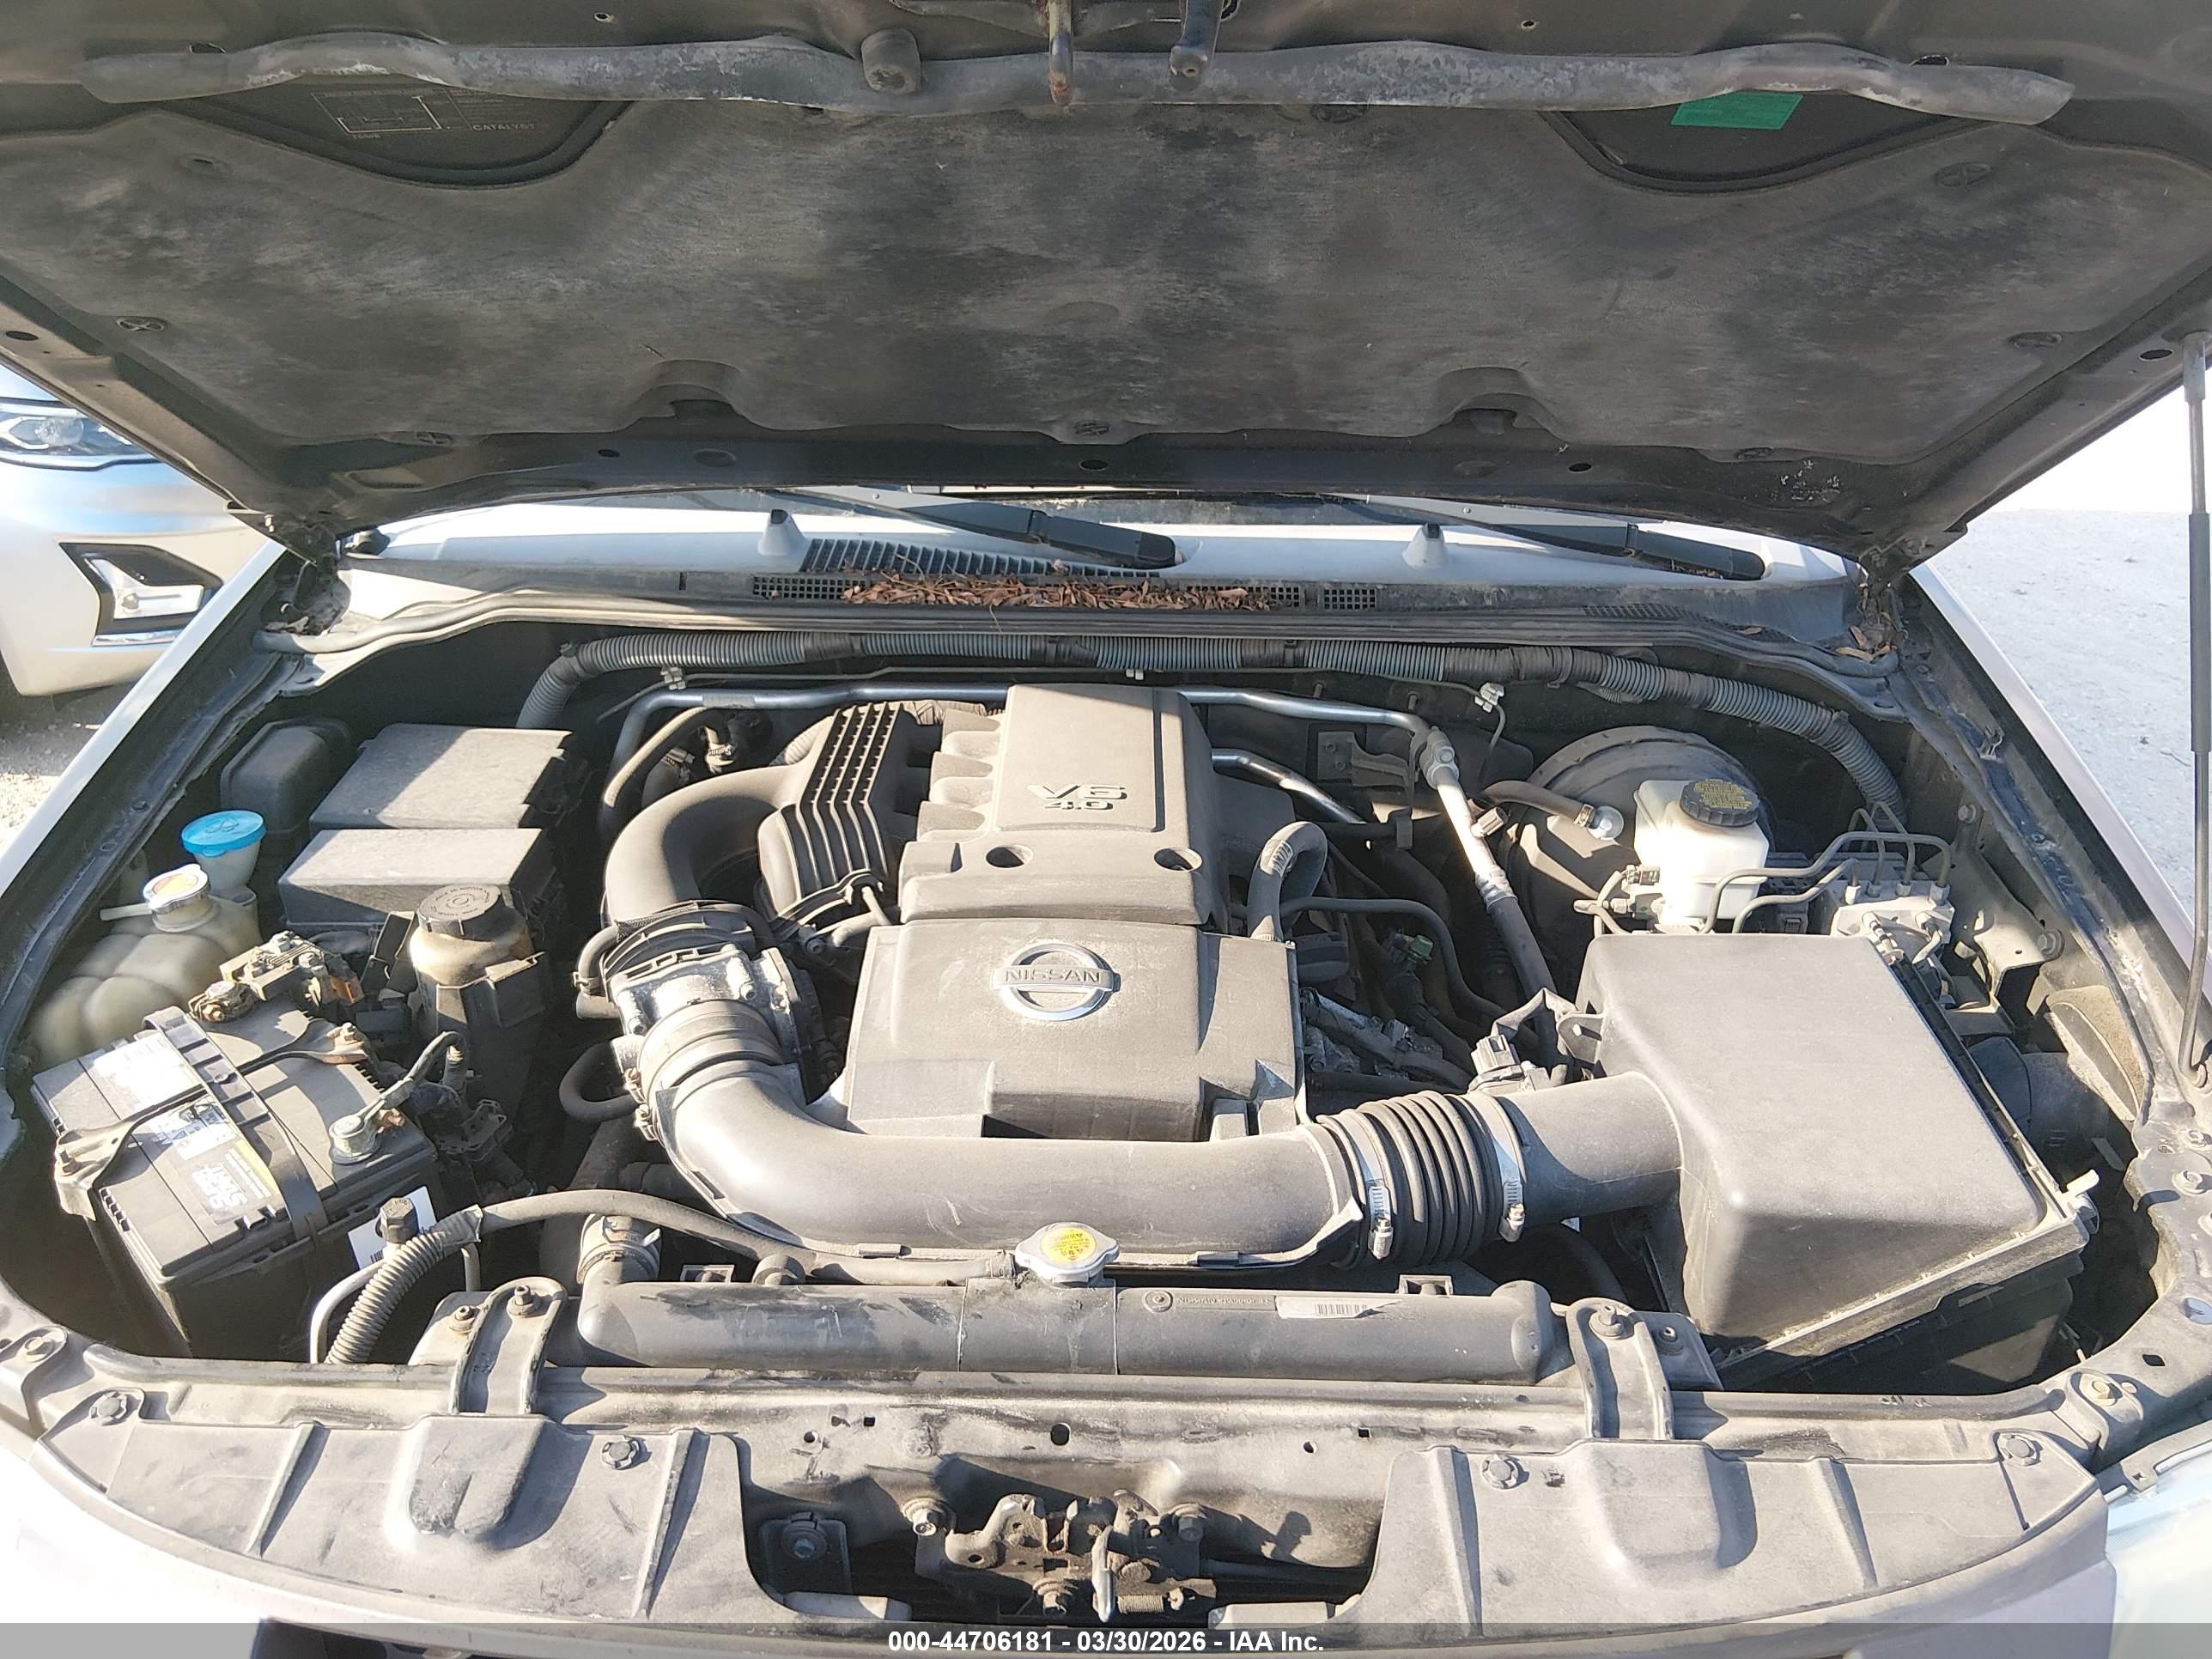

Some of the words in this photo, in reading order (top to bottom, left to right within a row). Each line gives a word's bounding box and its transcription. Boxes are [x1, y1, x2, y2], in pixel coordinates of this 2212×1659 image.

[1028, 783, 1127, 799] V6
[1043, 799, 1114, 810] 4.0
[1006, 968, 1101, 983] NISSAN
